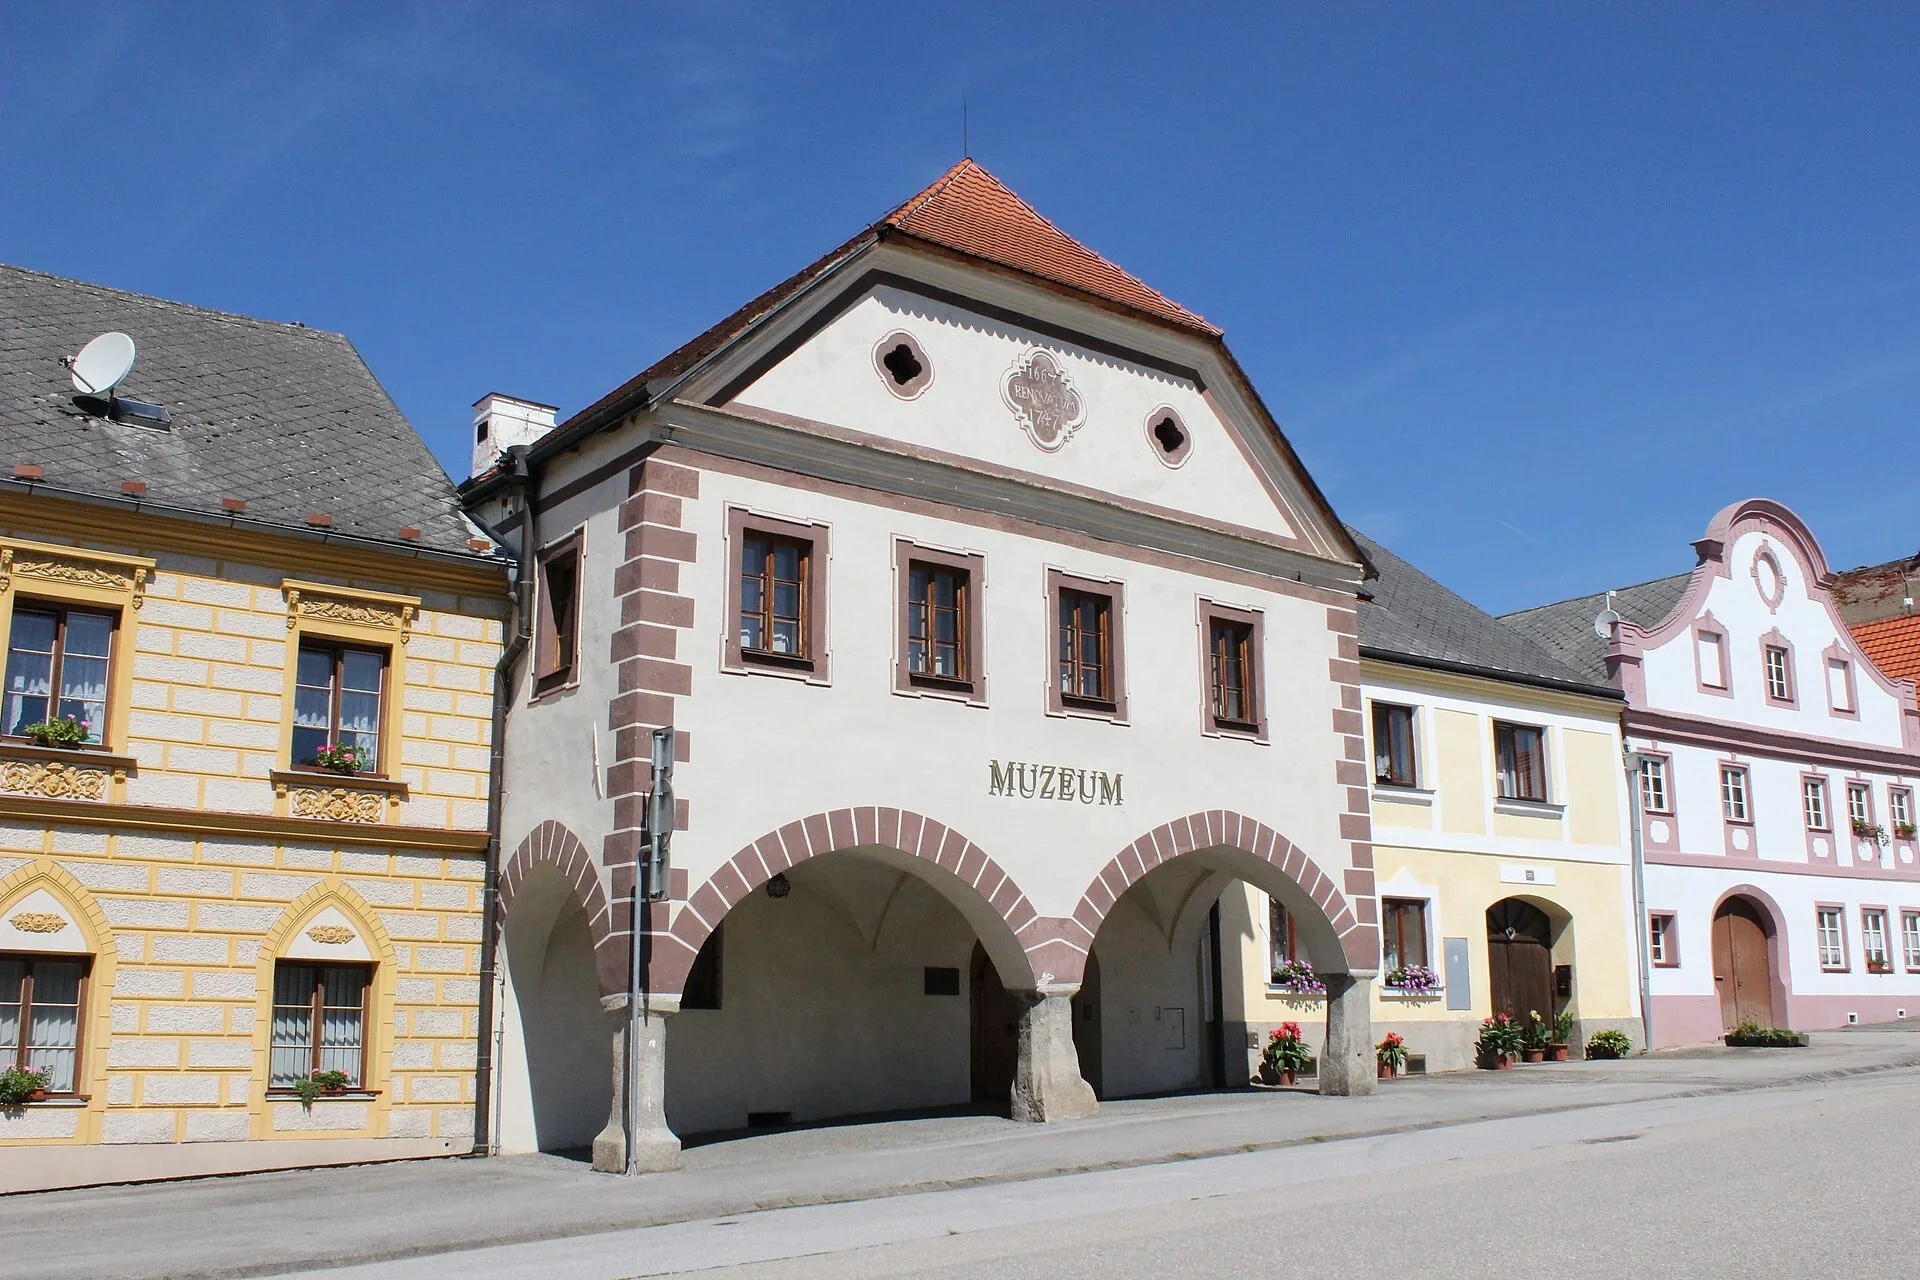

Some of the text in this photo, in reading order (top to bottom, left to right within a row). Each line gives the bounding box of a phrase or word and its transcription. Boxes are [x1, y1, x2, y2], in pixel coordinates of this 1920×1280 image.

[1029, 367, 1057, 386] 1667
[1029, 408, 1060, 431] 1747
[988, 759, 1124, 806] MUZEUM
